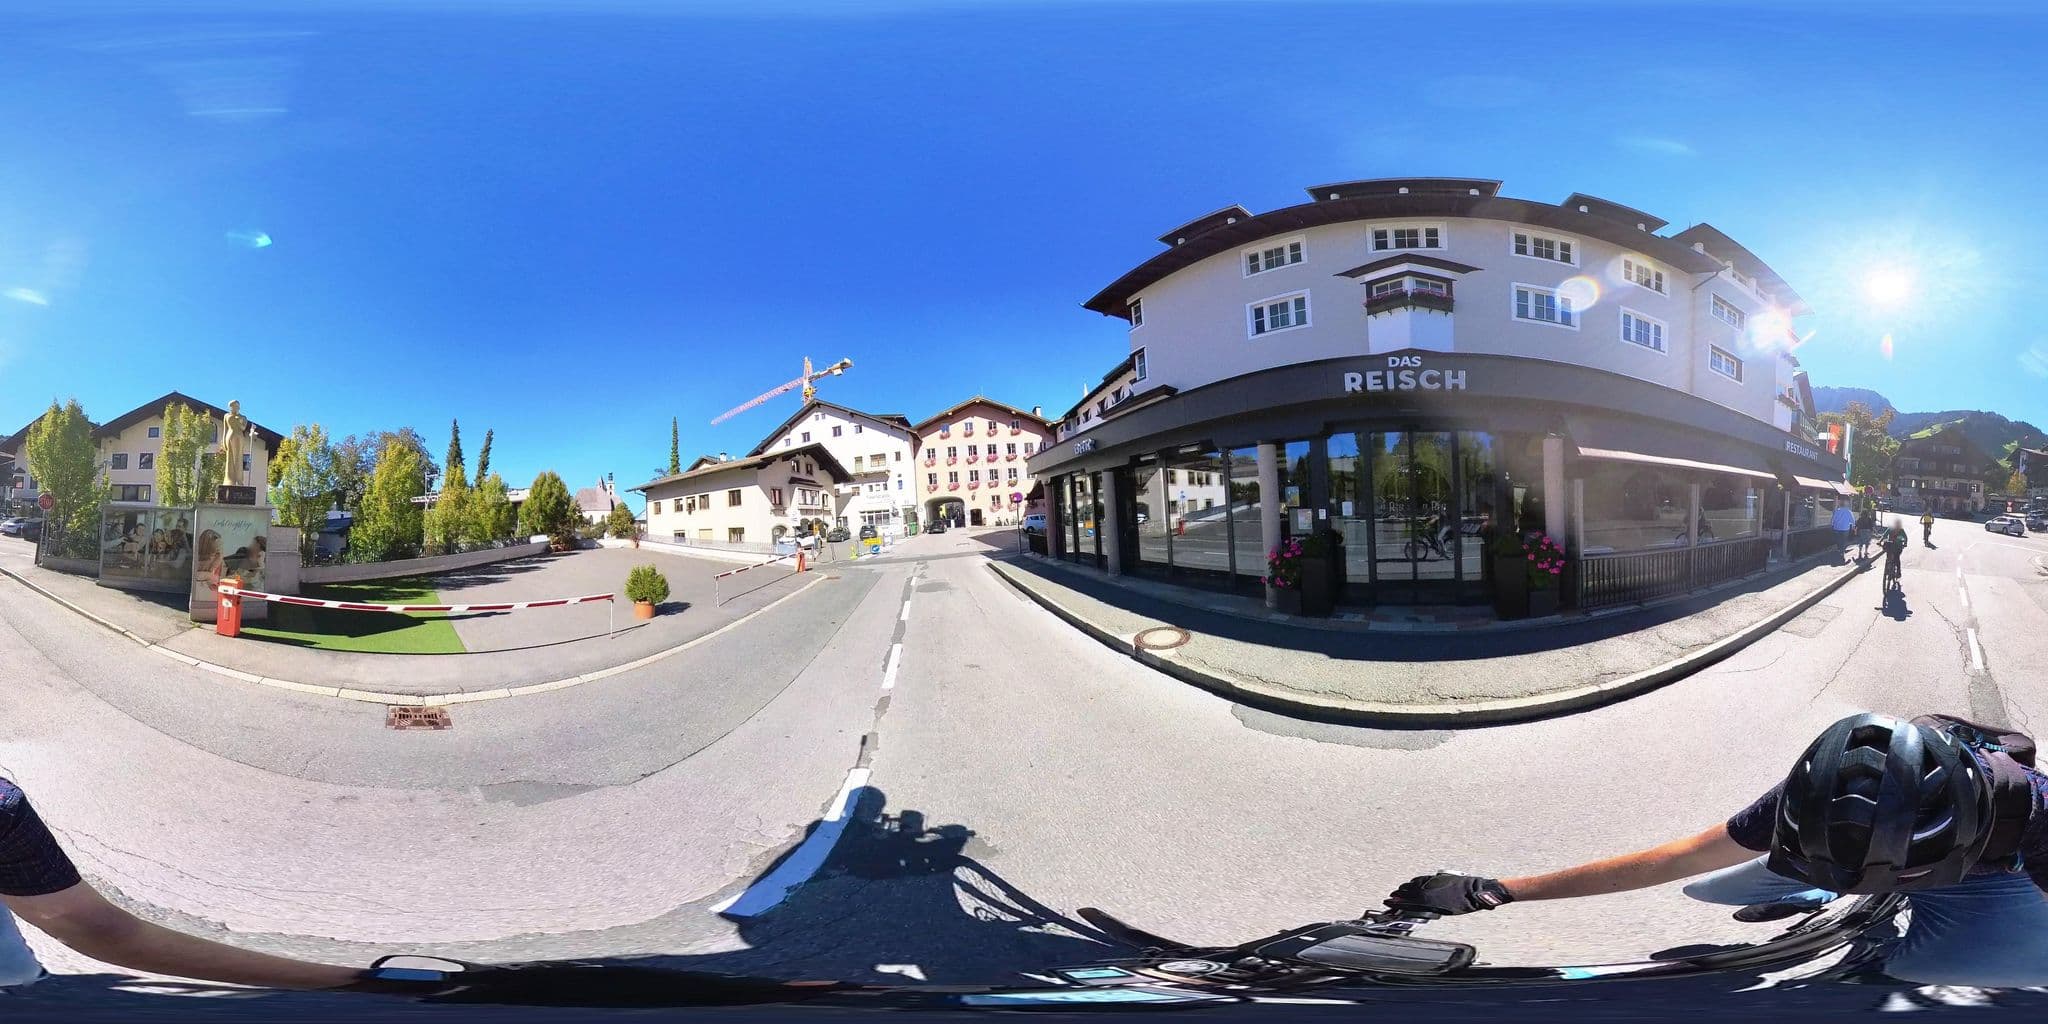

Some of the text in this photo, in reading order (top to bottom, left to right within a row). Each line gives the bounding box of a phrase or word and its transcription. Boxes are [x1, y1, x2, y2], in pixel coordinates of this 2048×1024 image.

[1388, 356, 1421, 367] DAS
[1344, 369, 1466, 392] REISCH
[1785, 440, 1818, 462] RESTAURANT
